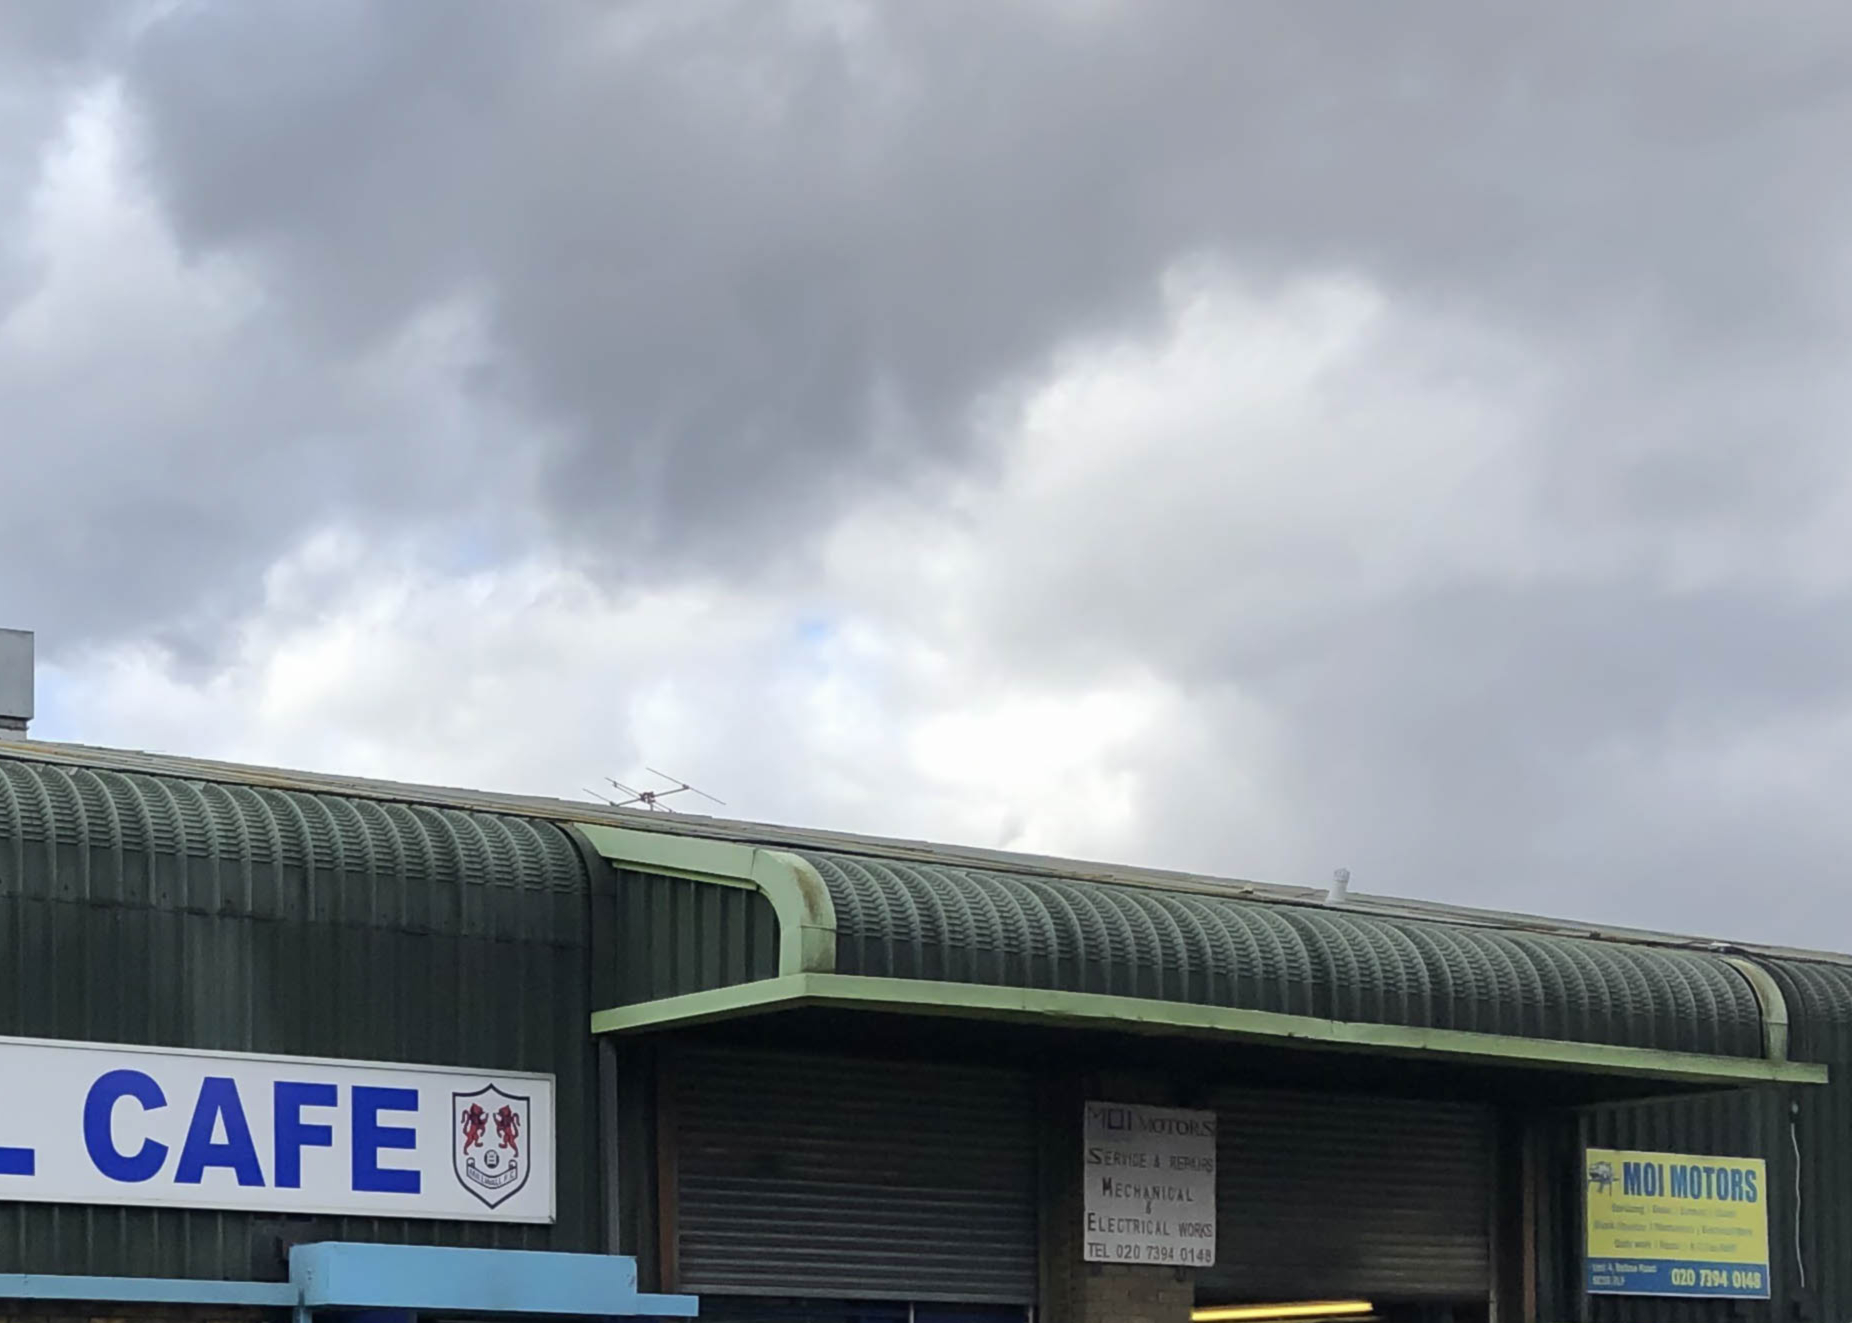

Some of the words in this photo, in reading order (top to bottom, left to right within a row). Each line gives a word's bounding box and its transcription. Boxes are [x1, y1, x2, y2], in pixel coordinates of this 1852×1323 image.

[83, 1068, 421, 1194] CAFE
[1088, 1147, 1147, 1169] SERVICE
[1169, 1155, 1214, 1173] REPAIRS
[1102, 1176, 1194, 1202] MECHANICAL
[1623, 1161, 1665, 1197] MOI
[1669, 1164, 1758, 1203] MOTORS
[1087, 1212, 1171, 1236] ELECTRICAL
[1178, 1222, 1213, 1238] WORKS
[1087, 1242, 1110, 1258] TEL
[1116, 1244, 1141, 1259] 020
[1146, 1245, 1174, 1260] 7394
[1180, 1247, 1212, 1262] 0148
[1671, 1268, 1696, 1286] 020
[1699, 1269, 1728, 1288] 7394
